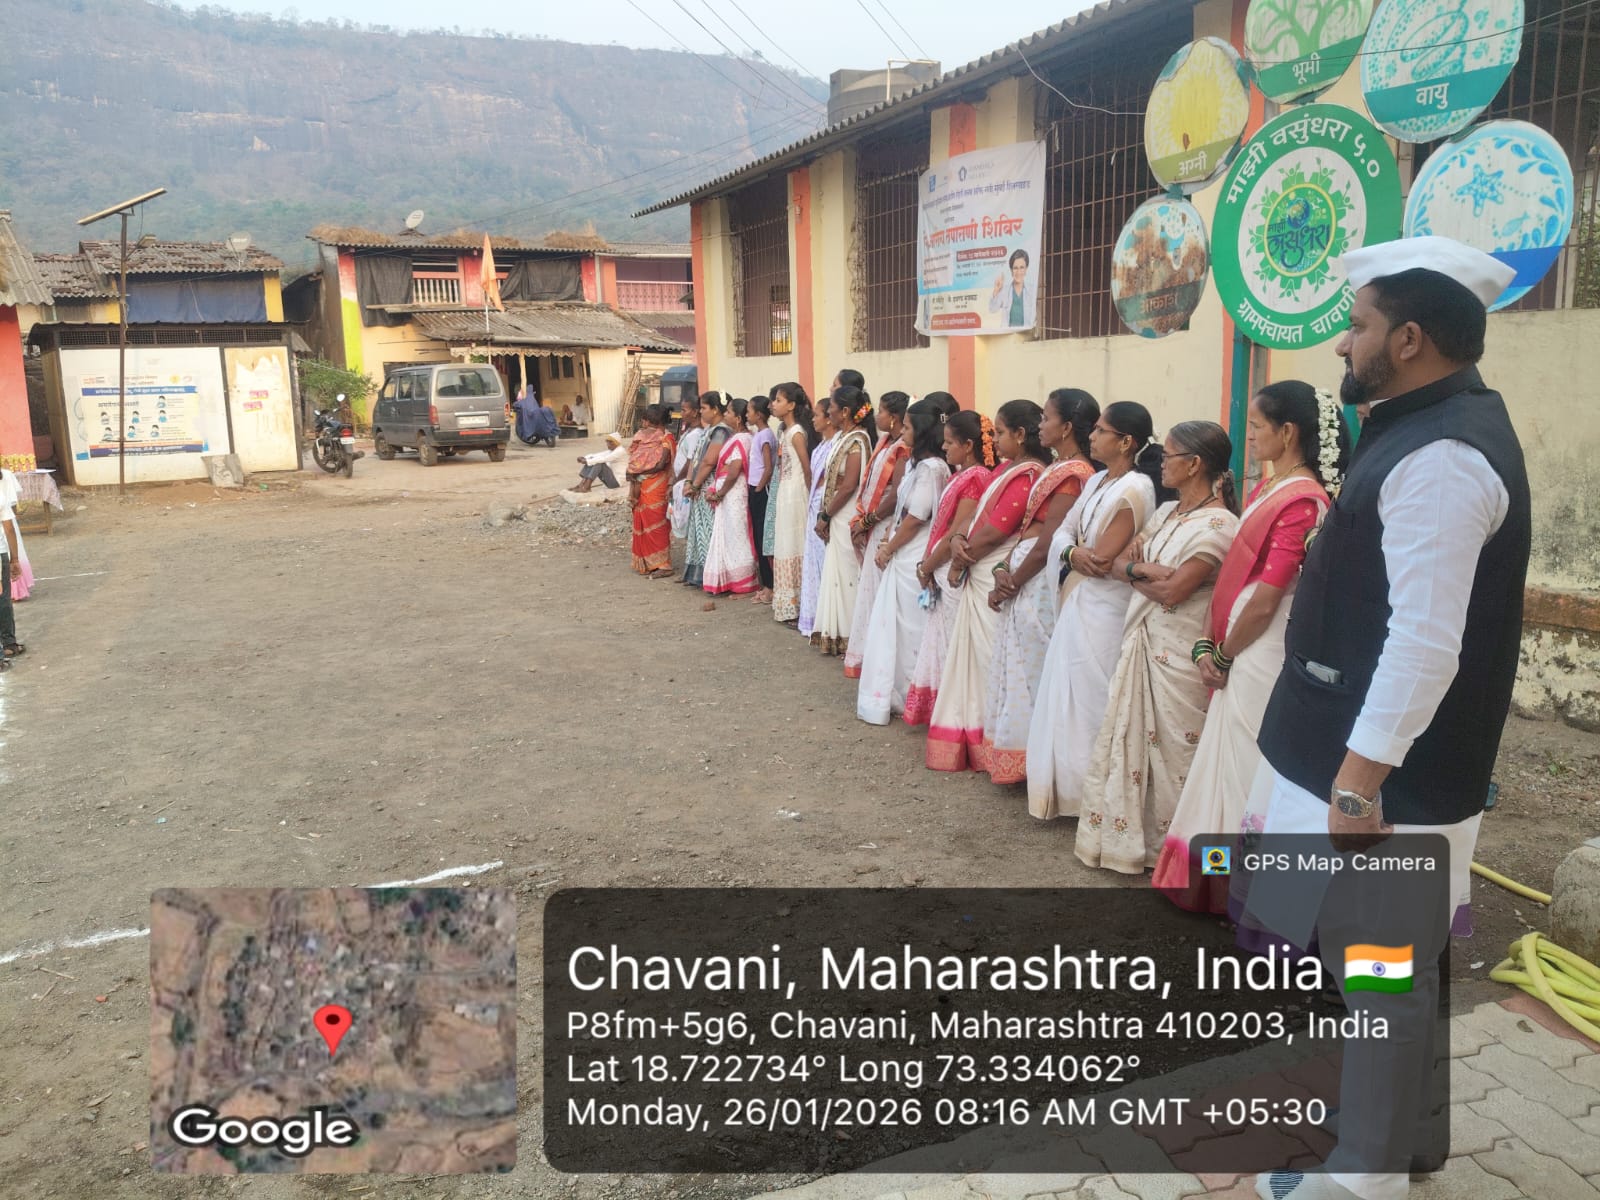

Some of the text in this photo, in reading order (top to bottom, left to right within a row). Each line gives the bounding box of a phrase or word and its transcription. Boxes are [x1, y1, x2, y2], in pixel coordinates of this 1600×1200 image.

[1292, 51, 1321, 85] भूमी
[1415, 83, 1449, 110] वायु
[1177, 150, 1208, 177] अग्नी
[1226, 140, 1268, 204] माझी
[1270, 113, 1353, 145] वसुंधरा
[1237, 285, 1358, 344] ग्रामपंचायत चावणी
